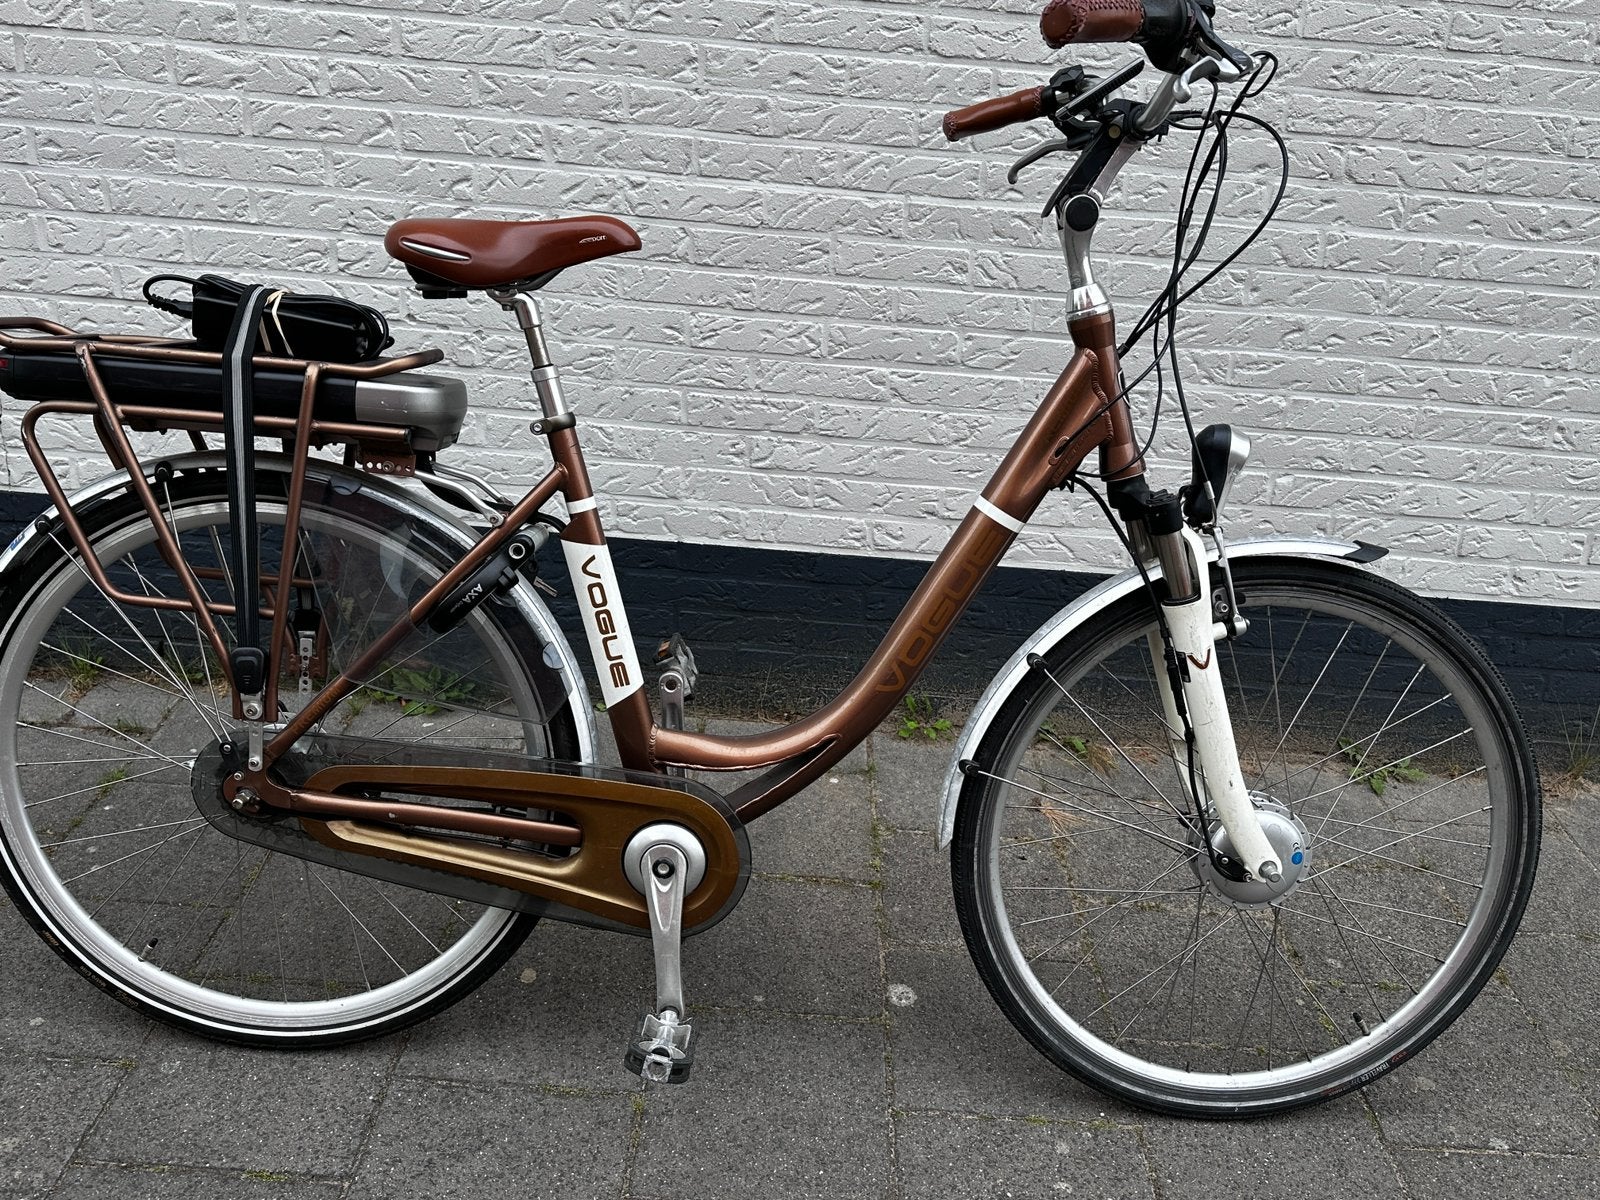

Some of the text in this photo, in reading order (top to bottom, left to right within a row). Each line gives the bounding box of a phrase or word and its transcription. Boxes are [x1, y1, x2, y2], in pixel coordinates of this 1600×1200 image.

[462, 583, 483, 603] AXA
[581, 554, 631, 688] VOGUE
[875, 529, 1003, 692] VOGUE
[1360, 1061, 1390, 1081] TRAVELLER
